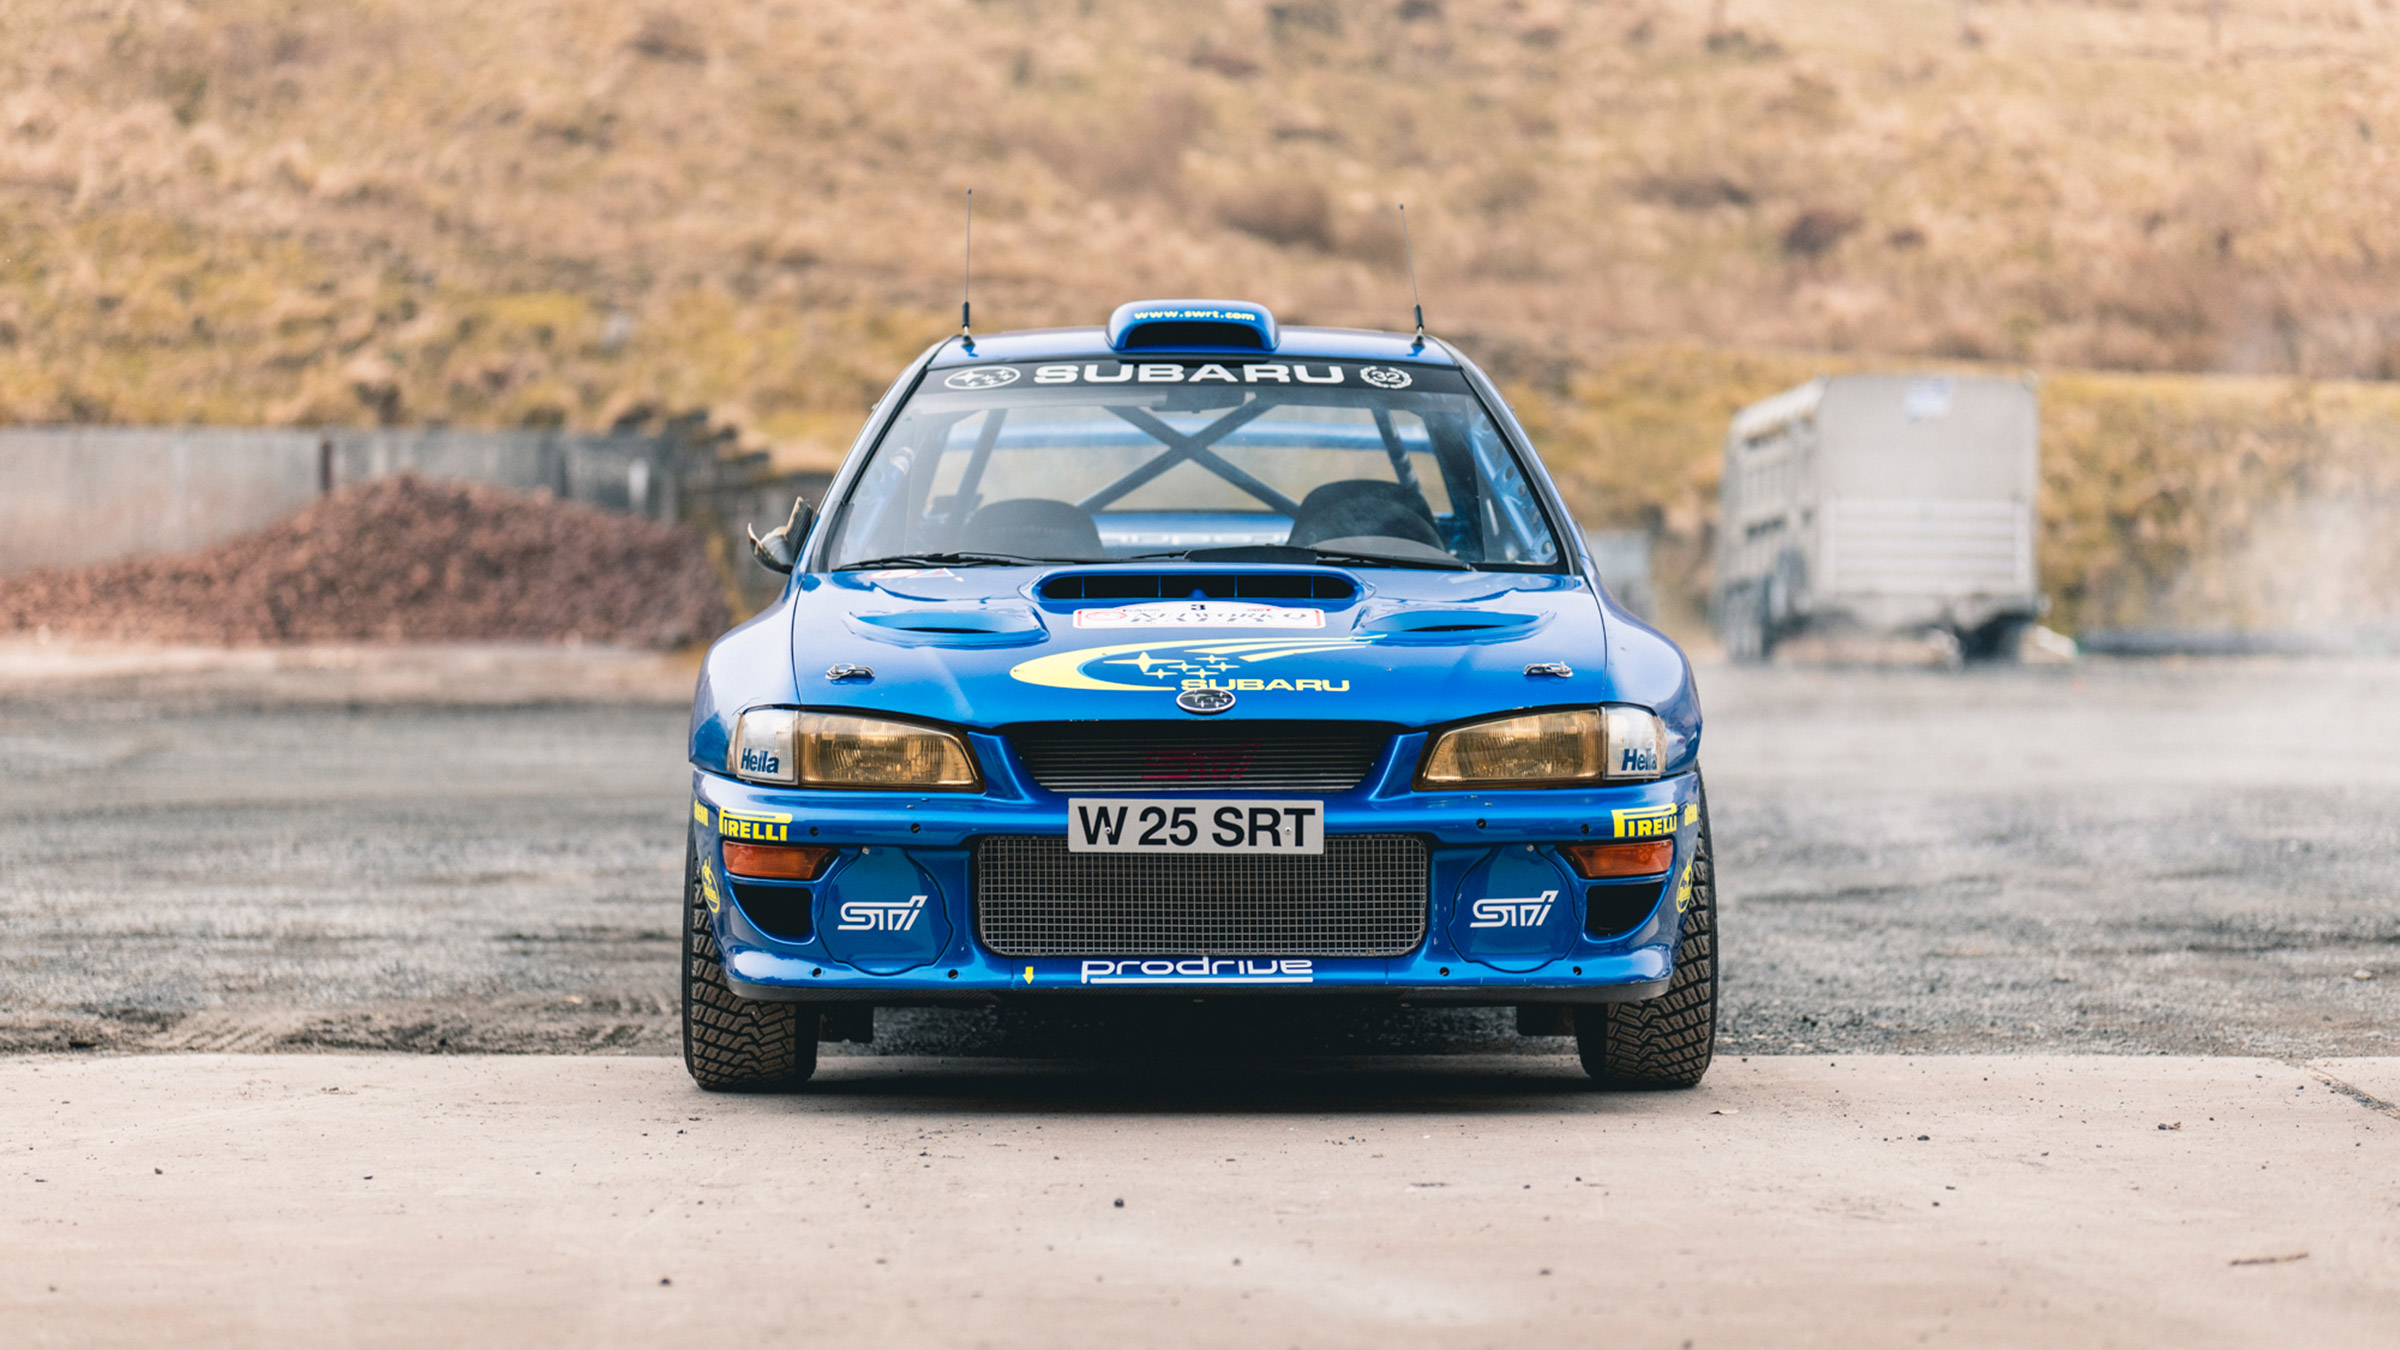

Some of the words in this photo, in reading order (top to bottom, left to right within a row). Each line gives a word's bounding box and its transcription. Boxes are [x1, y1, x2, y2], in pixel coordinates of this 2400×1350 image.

[1134, 310, 1256, 322] www.swrt.com
[1033, 363, 1345, 384] SUBARU
[1371, 370, 1402, 383] 32
[1181, 679, 1350, 692] SUBARU
[740, 748, 779, 774] Hella
[1621, 748, 1658, 771] Hella
[718, 807, 793, 841] PIRELLI
[1078, 806, 1128, 845] W
[1138, 806, 1198, 846] 25
[1211, 807, 1315, 847] SRT
[1611, 802, 1677, 838] PIRELLI
[1081, 956, 1314, 984] prodrive
